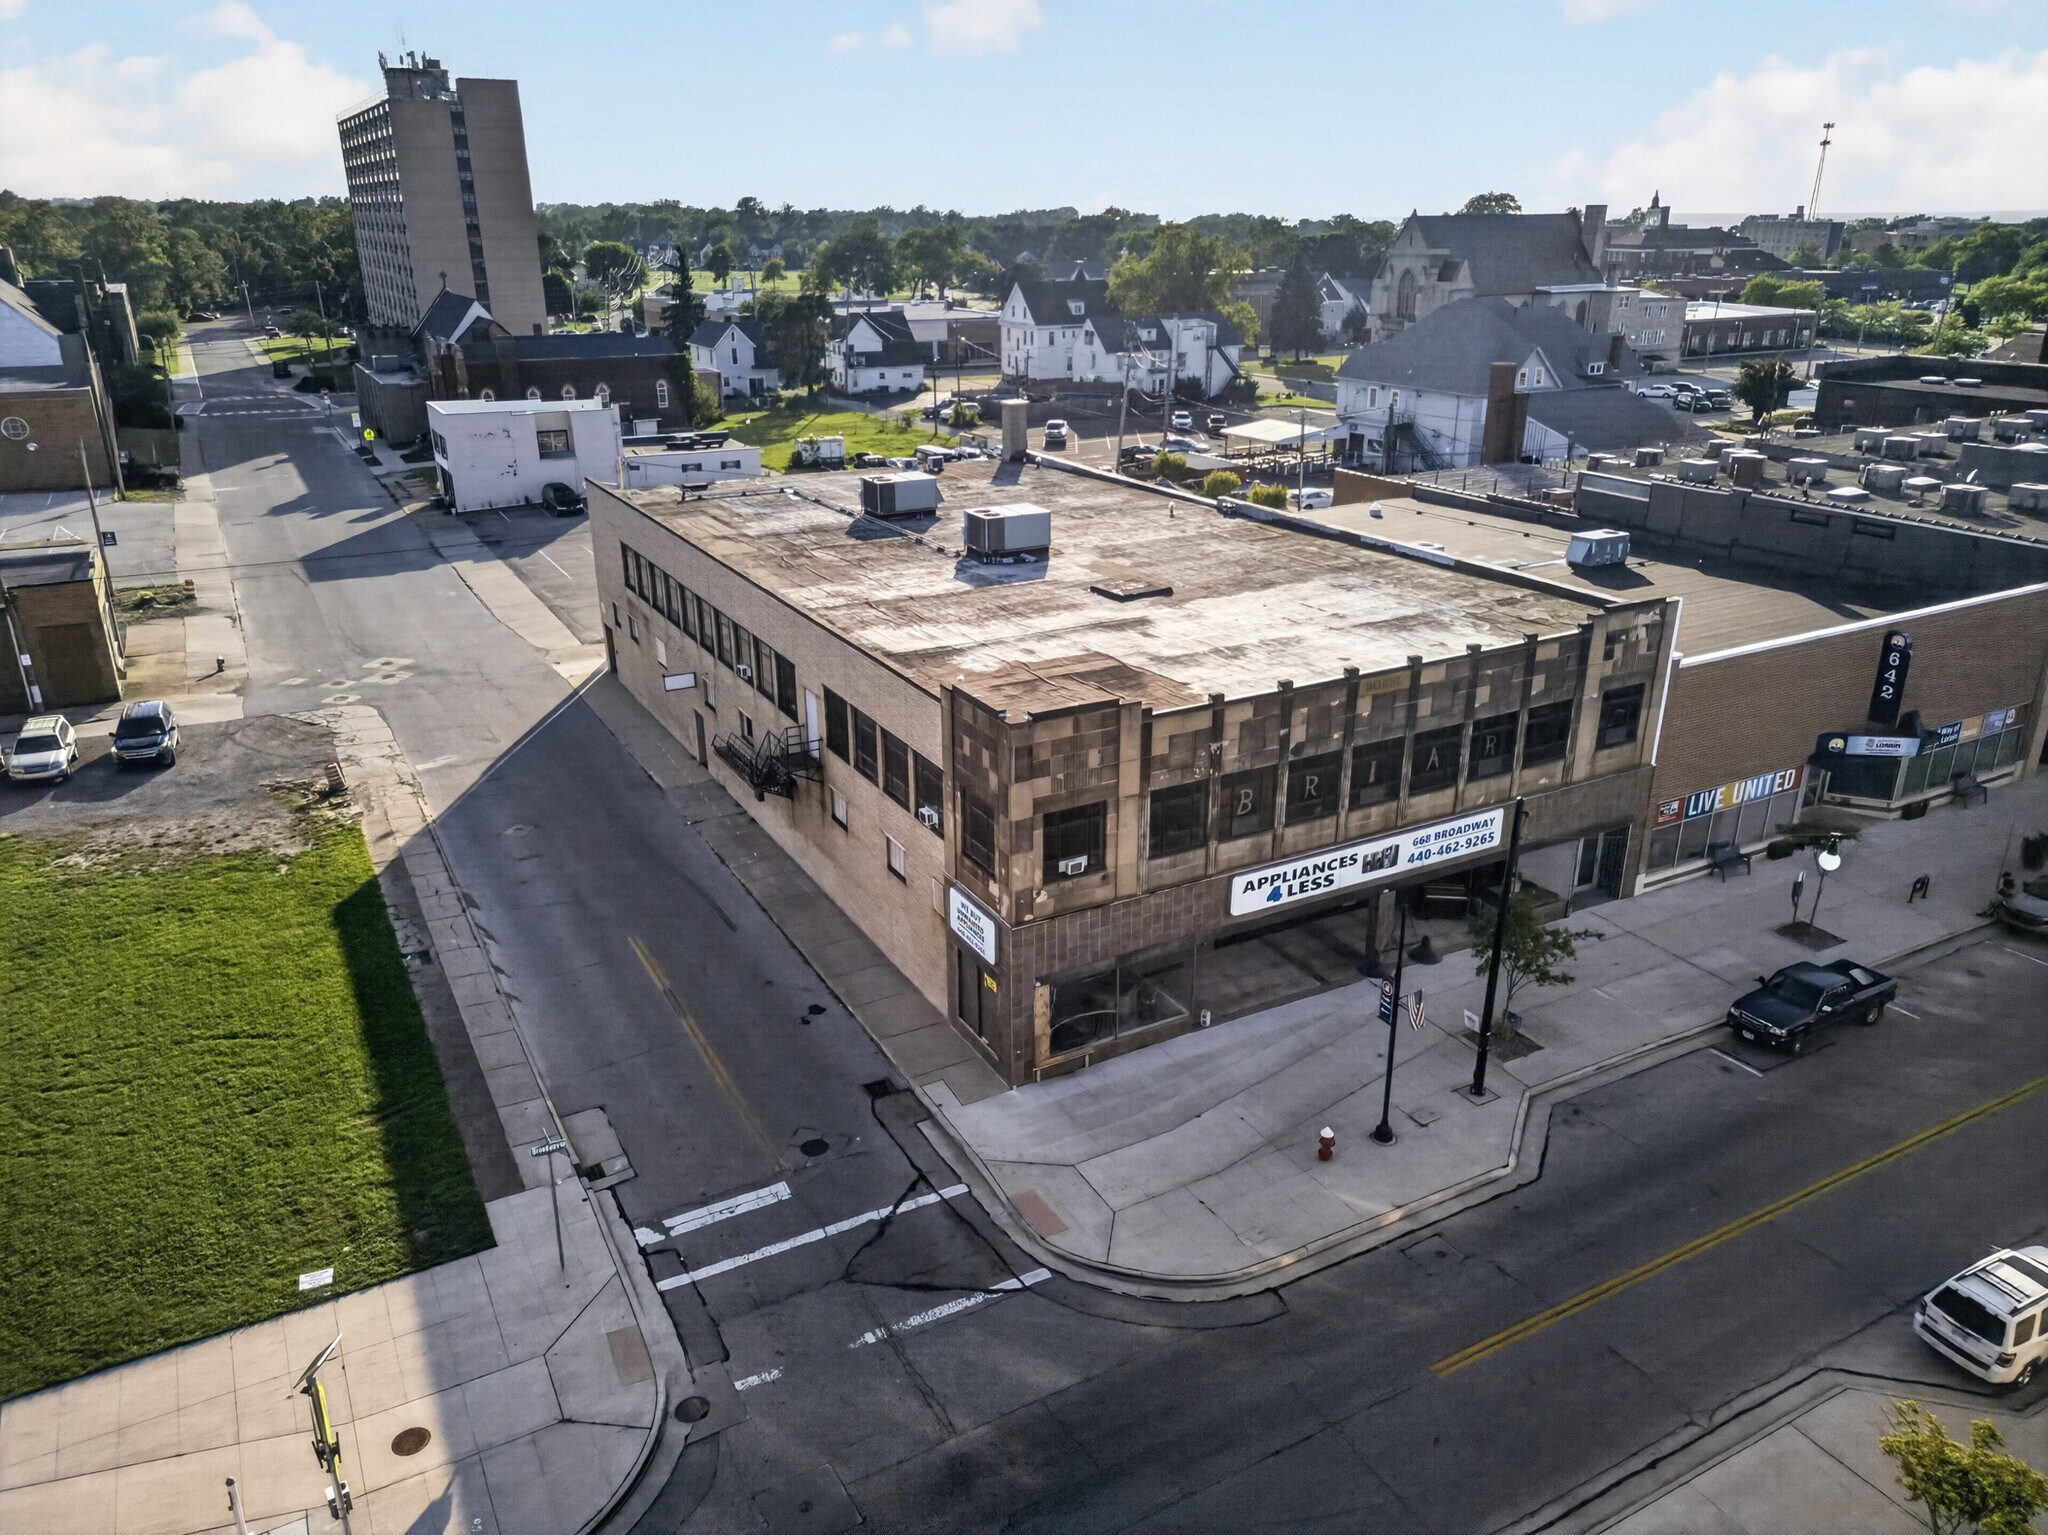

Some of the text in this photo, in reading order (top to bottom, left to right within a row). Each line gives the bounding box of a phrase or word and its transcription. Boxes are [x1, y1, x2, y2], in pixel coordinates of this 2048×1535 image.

[1880, 652, 1901, 699] 642
[1688, 787, 1726, 816] LIVE
[1732, 769, 1796, 804] UNITED
[1407, 831, 1495, 864] 440-462-9265
[1412, 817, 1496, 847] 668 BROADWAY
[1242, 853, 1358, 894] APPLIANCES
[1266, 873, 1335, 902] 4 LESS
[970, 909, 981, 924] BUY
